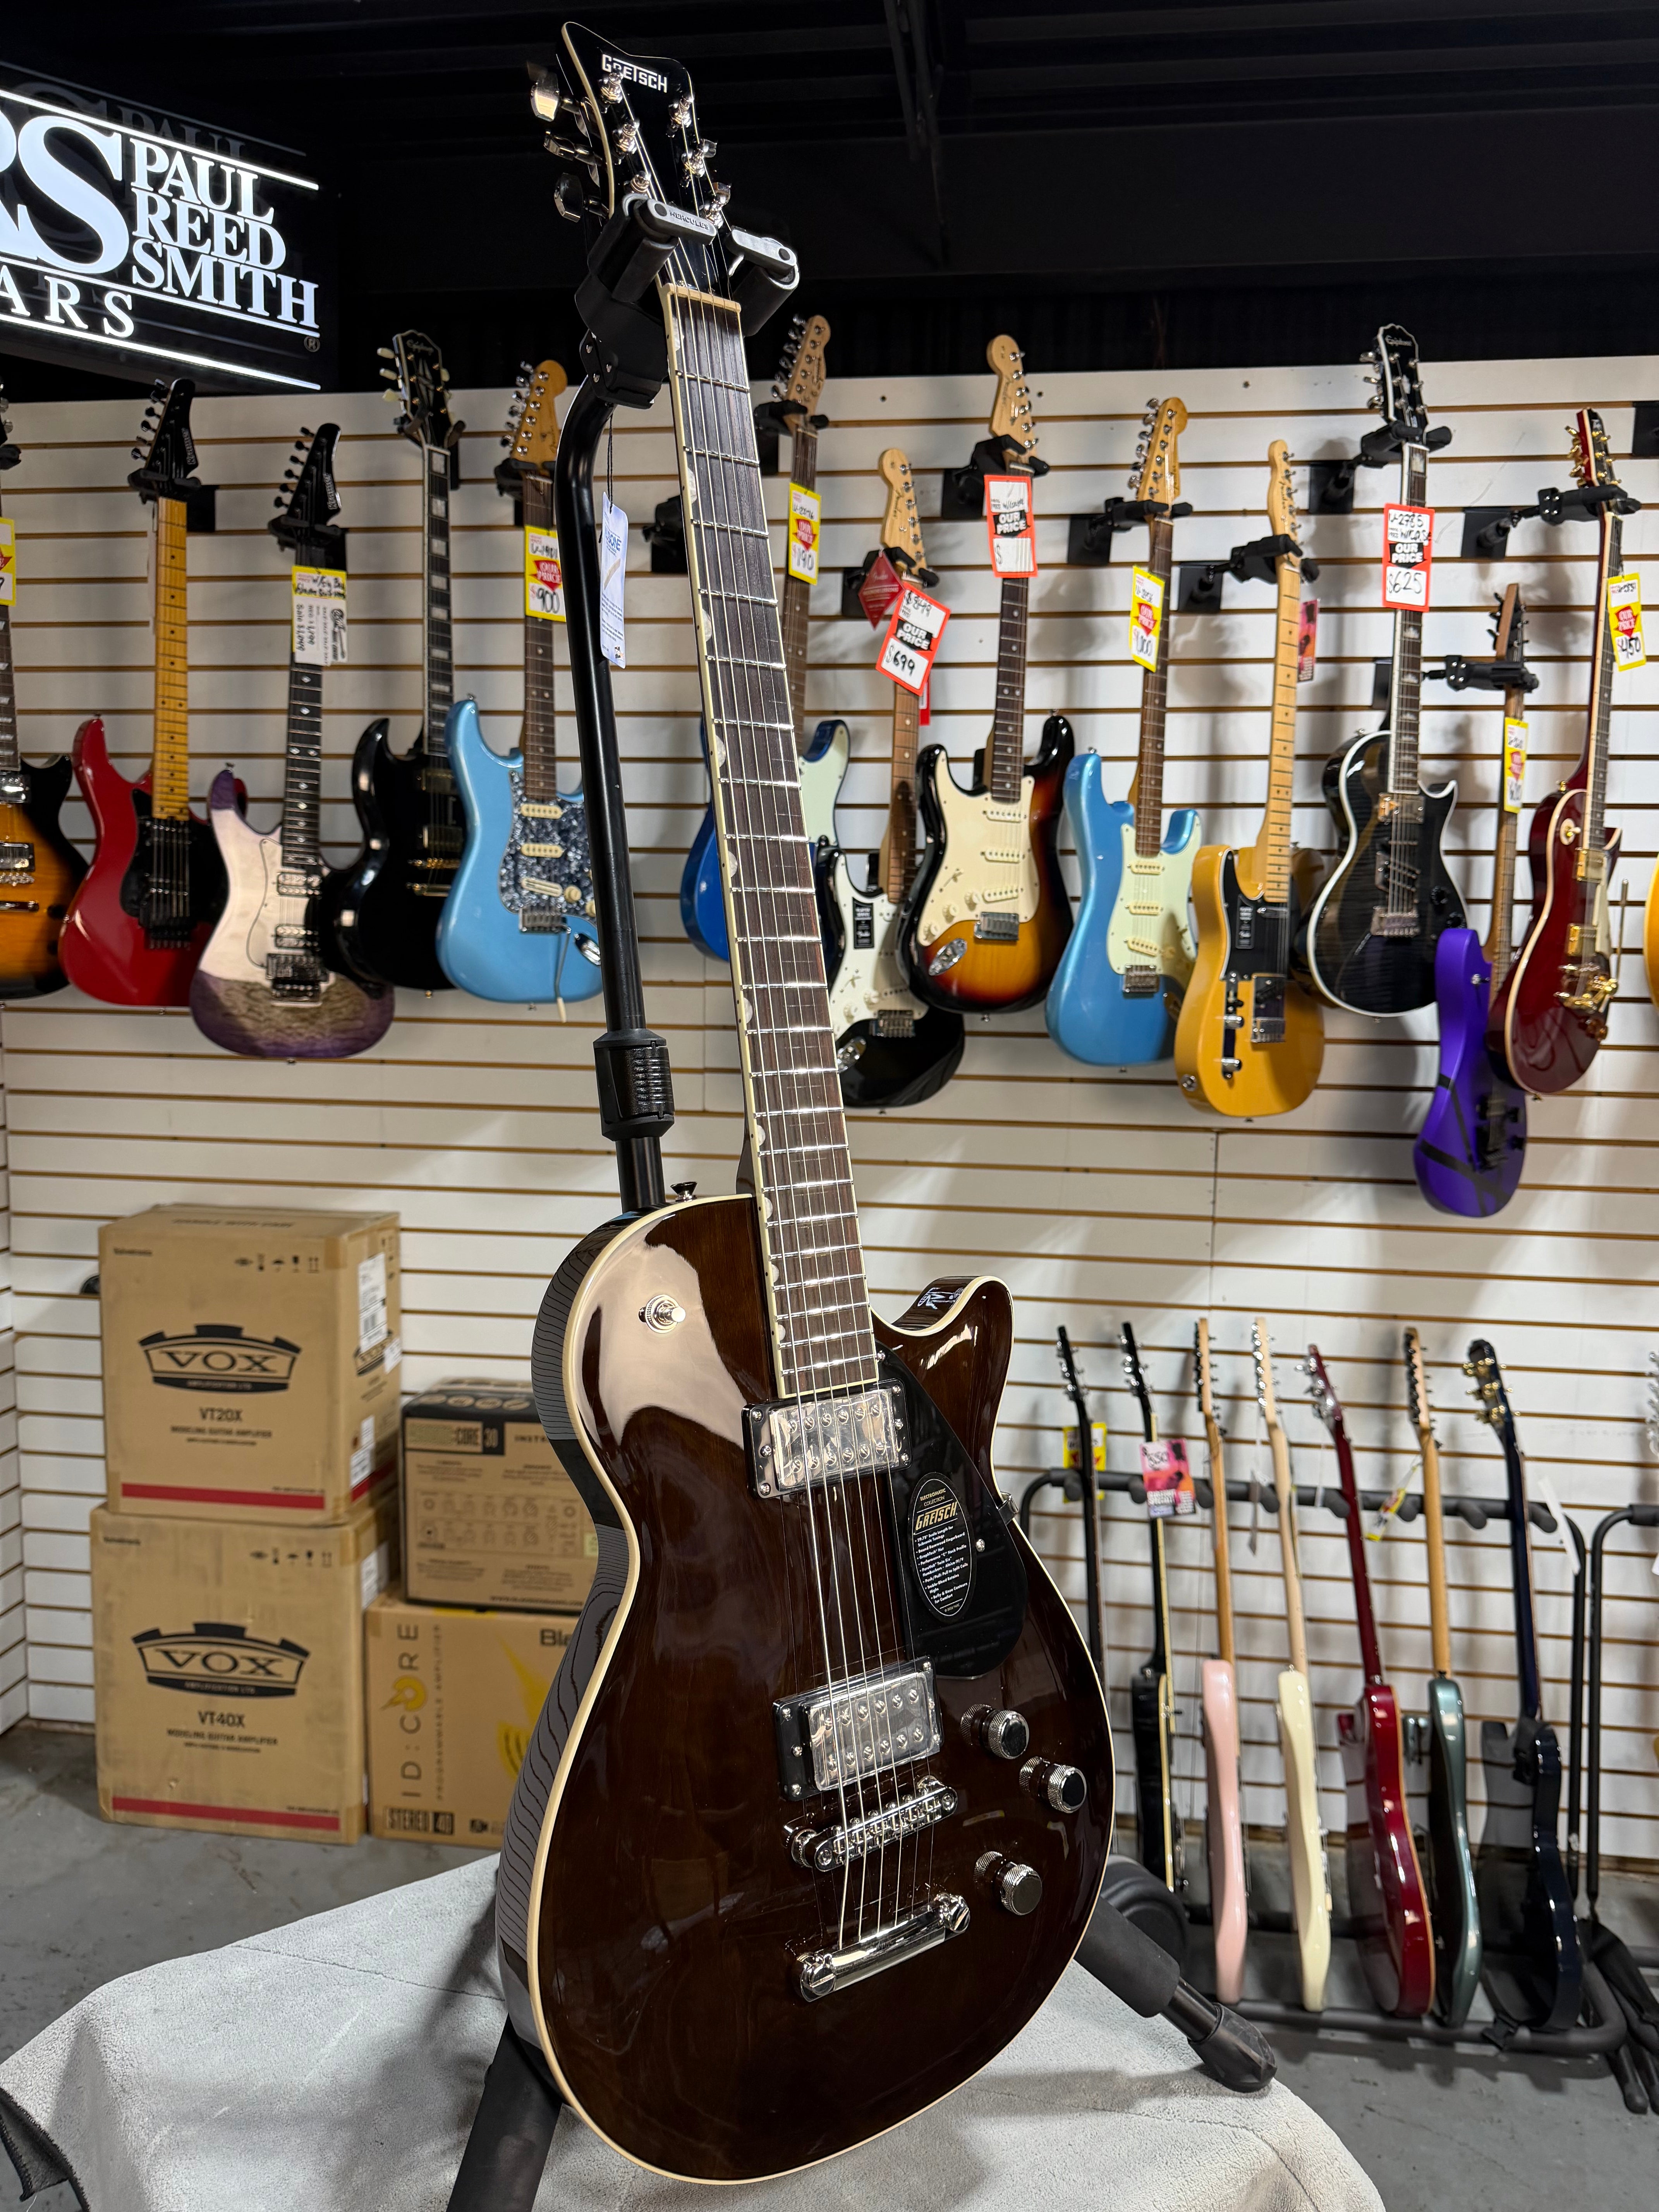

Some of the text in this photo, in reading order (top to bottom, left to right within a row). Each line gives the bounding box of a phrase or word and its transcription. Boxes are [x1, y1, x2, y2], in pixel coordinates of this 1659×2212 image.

[130, 137, 275, 225] PAUL
[131, 187, 286, 270] REED
[669, 210, 709, 230] HERCULES
[132, 238, 319, 329] SMITH
[322, 472, 338, 510] Kramer
[998, 512, 1020, 524] OUR
[996, 521, 1027, 534] PRICE
[1395, 543, 1419, 553] OUR
[1391, 552, 1424, 564] PRICE
[539, 562, 559, 574] OUR
[537, 570, 562, 584] PRICE
[1618, 609, 1633, 622] OUR
[1618, 617, 1635, 631] PRICE
[902, 622, 927, 639] OUR
[896, 628, 930, 651] PRICE
[159, 1350, 277, 1374] VOX
[199, 1406, 244, 1423] VT20X
[920, 1488, 946, 1501] ELECTROMATIC
[924, 1496, 945, 1506] COLLECTION
[915, 1501, 957, 1530] GRETSCH
[946, 1532, 965, 1542] Fingerboard
[155, 1647, 284, 1678] VOX
[197, 1710, 245, 1729] VT40X
